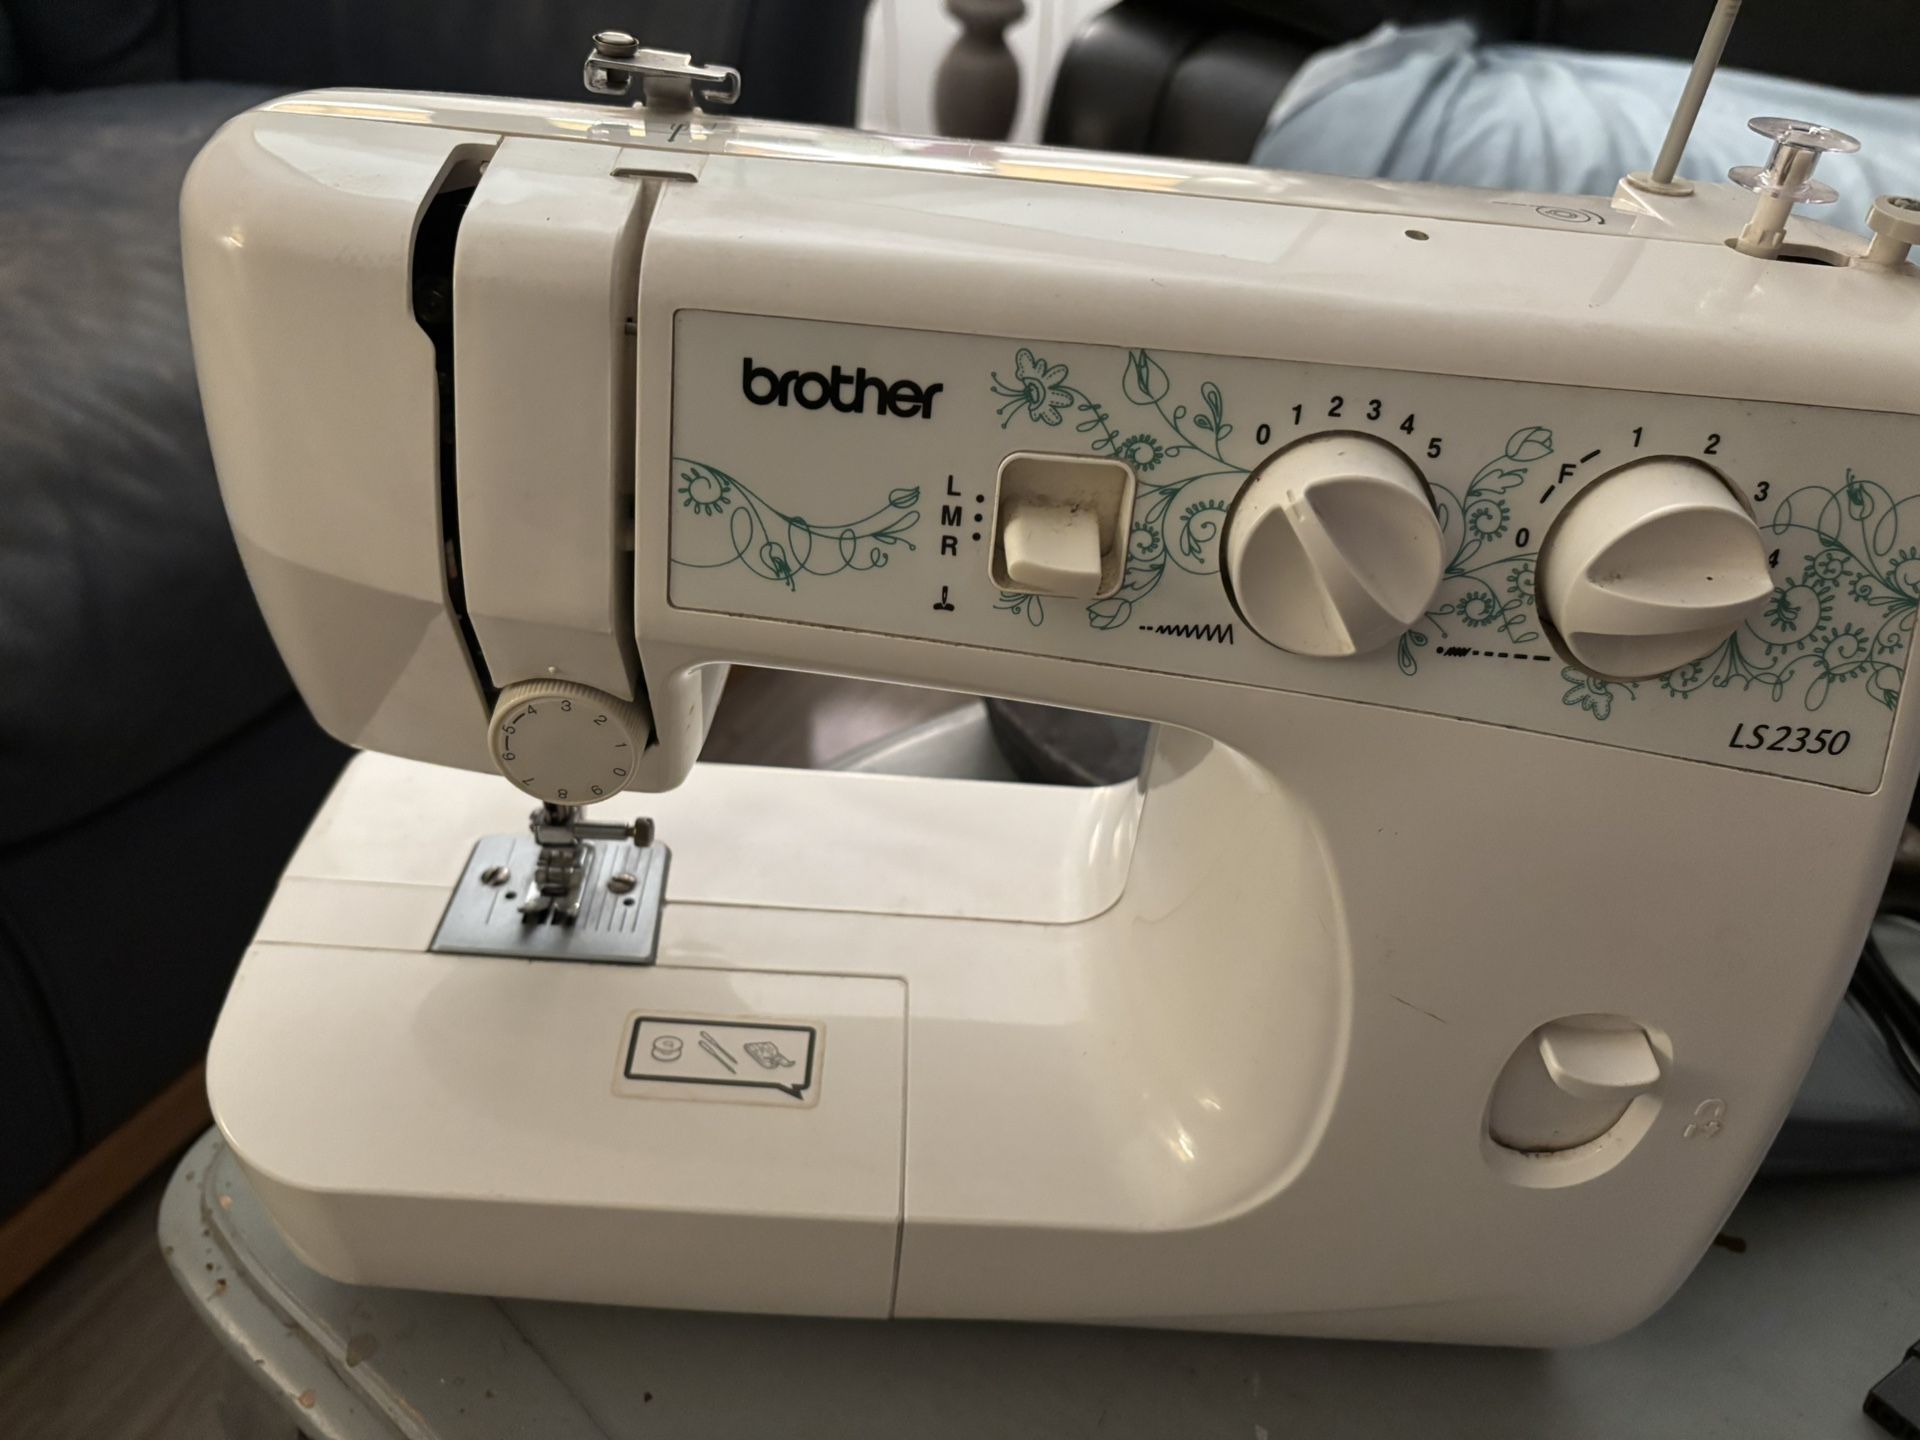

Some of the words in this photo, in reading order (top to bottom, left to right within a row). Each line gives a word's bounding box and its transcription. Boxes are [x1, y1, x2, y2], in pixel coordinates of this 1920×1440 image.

[742, 357, 943, 419] brother
[1256, 423, 1271, 445] 0
[1292, 404, 1302, 425] 1
[1328, 396, 1344, 417] 2
[1366, 399, 1382, 420] 3
[1400, 413, 1415, 435] 4
[1427, 437, 1442, 458] 5
[947, 474, 961, 496] L
[1515, 527, 1529, 547] 0
[1558, 463, 1576, 484] F
[1632, 426, 1643, 447] 1
[1703, 433, 1720, 454] 2
[1754, 481, 1770, 501] 3
[1768, 549, 1780, 568] 4
[941, 505, 962, 526] M
[941, 535, 957, 556] R
[527, 704, 538, 715] 4
[561, 700, 572, 712] 3
[502, 725, 516, 735] 5
[593, 714, 608, 726] 2
[1728, 723, 1851, 756] LS2350
[557, 788, 568, 800] 8
